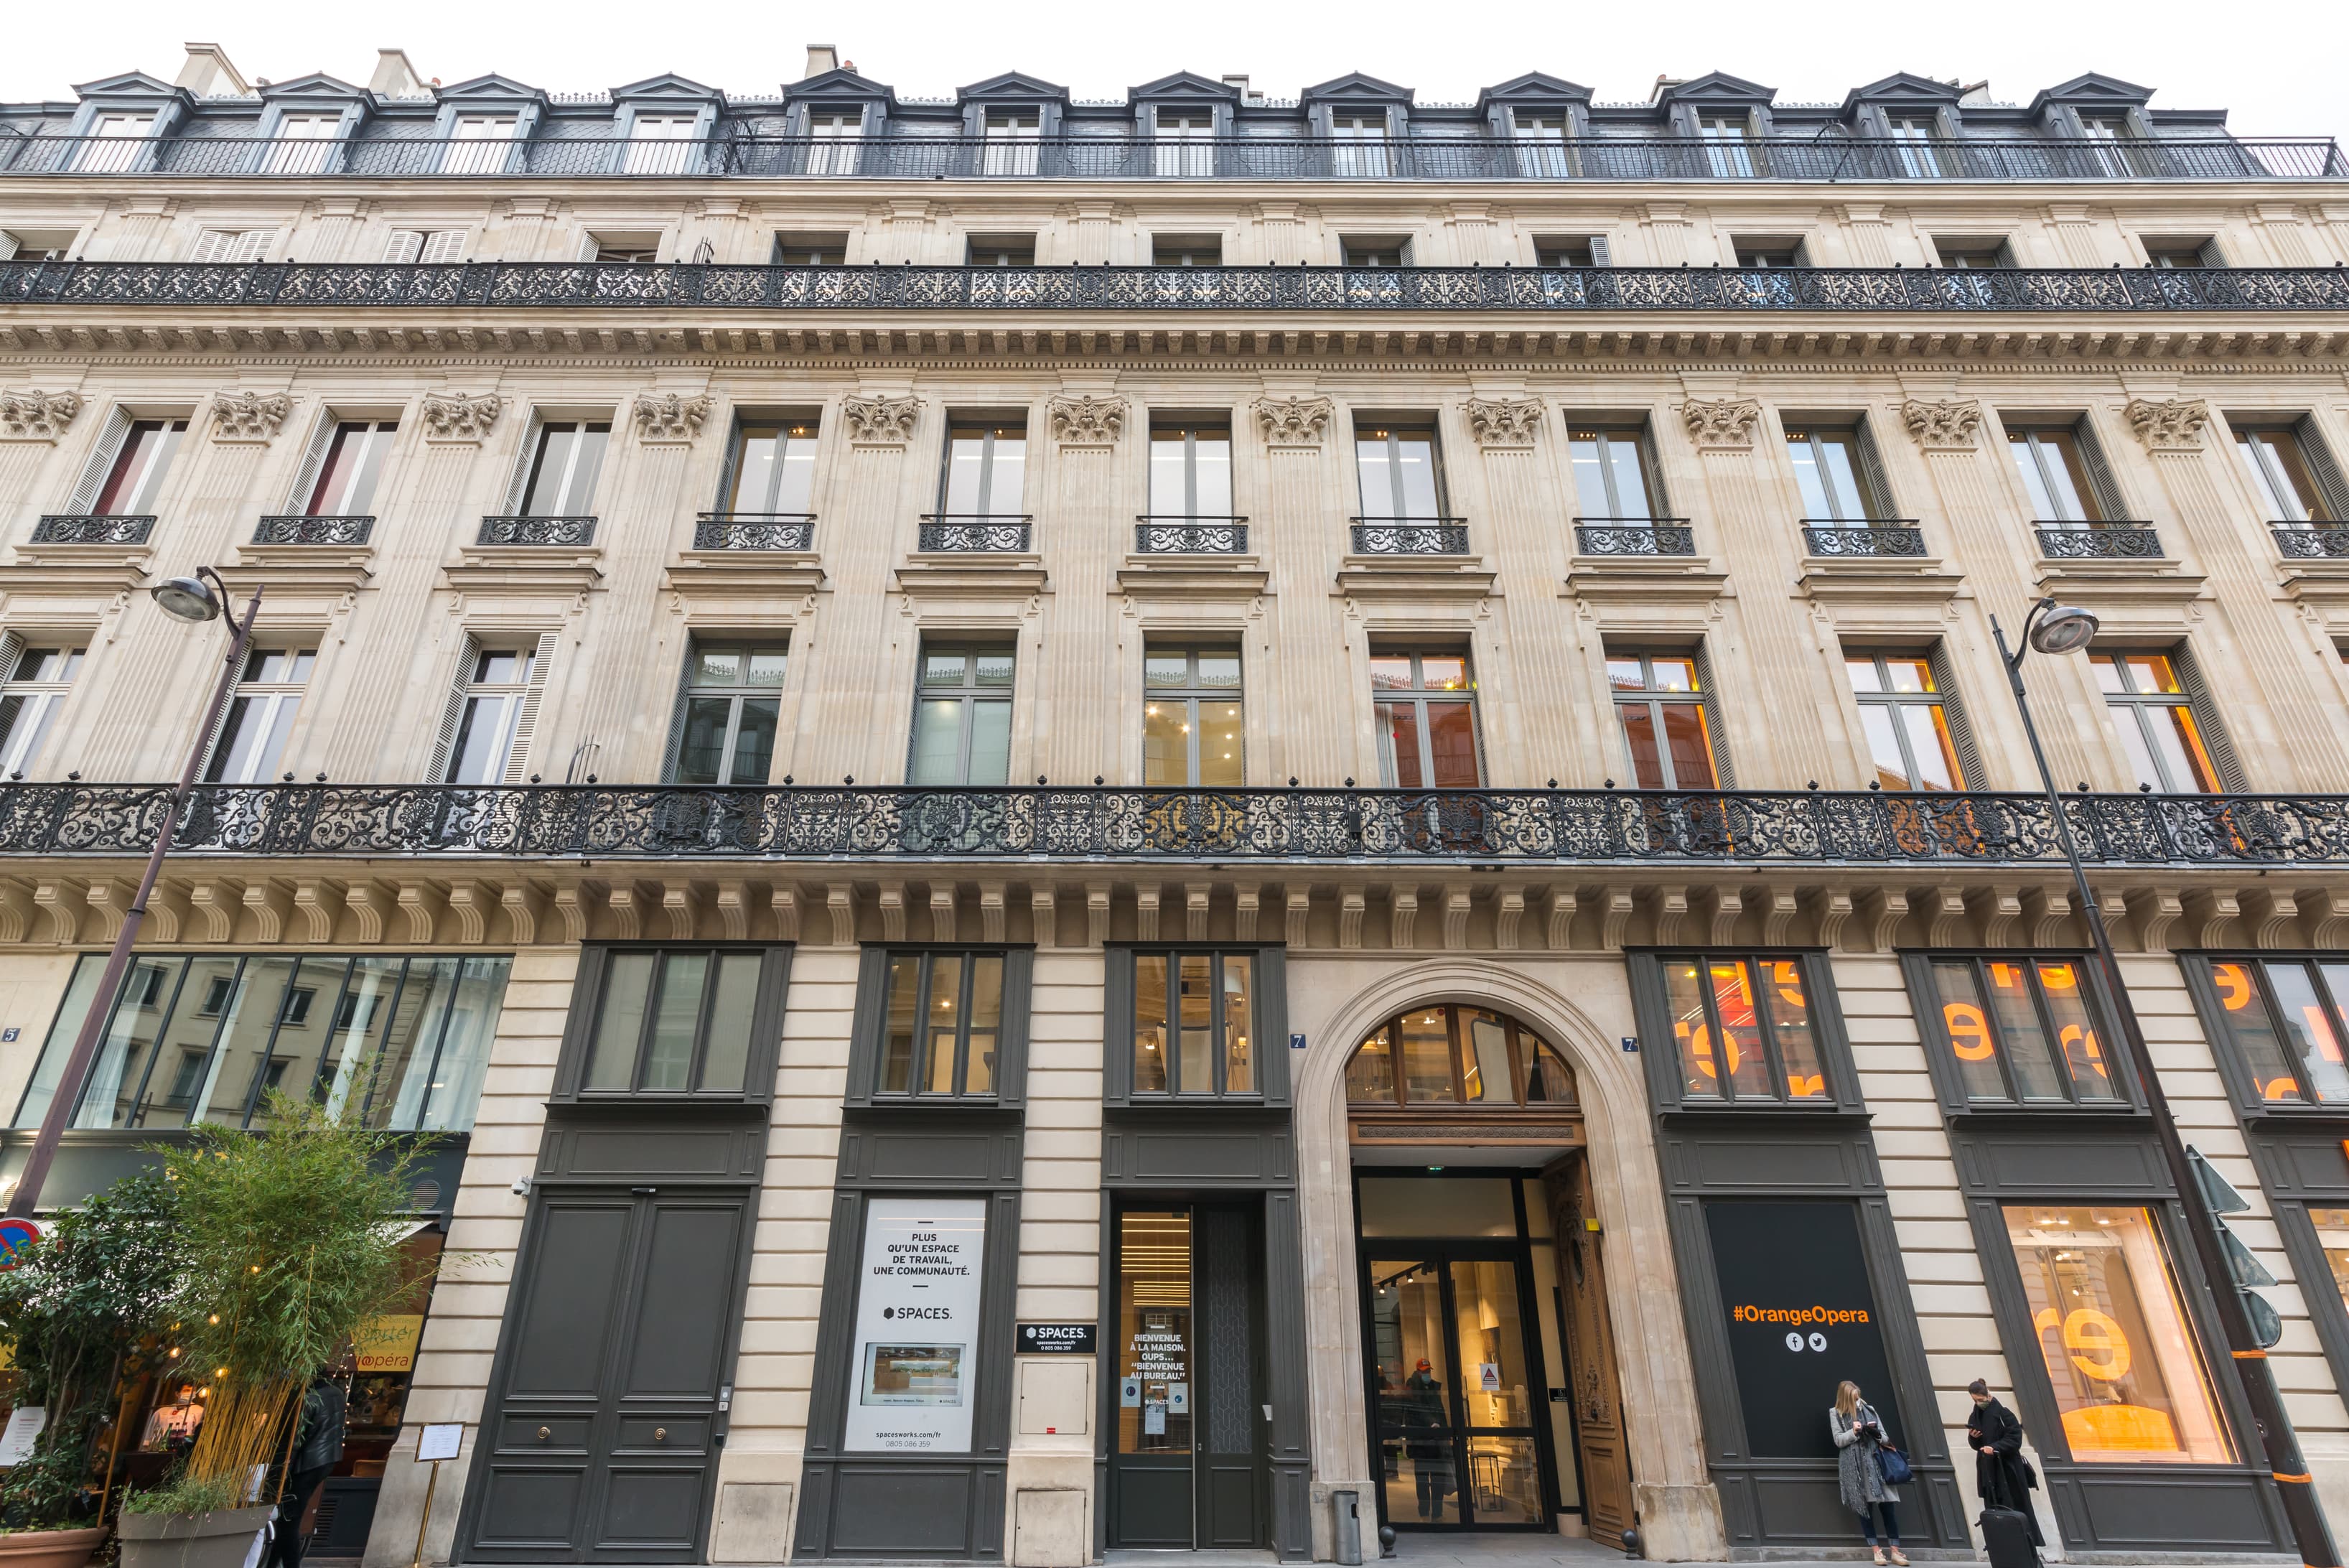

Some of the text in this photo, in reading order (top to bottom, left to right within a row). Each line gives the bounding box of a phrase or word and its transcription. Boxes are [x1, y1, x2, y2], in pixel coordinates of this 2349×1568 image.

[5, 1029, 17, 1041] 5
[1294, 1035, 1302, 1047] 7
[1625, 1038, 1633, 1050] 7
[887, 1244, 919, 1253] QU'UN
[909, 1256, 953, 1265] TRAVAIL,
[873, 1265, 970, 1276] UNE COMMUNAUTÉ.
[897, 1307, 953, 1320] SPACES.
[1734, 1305, 1869, 1326] #OrangeOpera
[1038, 1327, 1087, 1338] SPACES.
[1130, 1341, 1136, 1351] À
